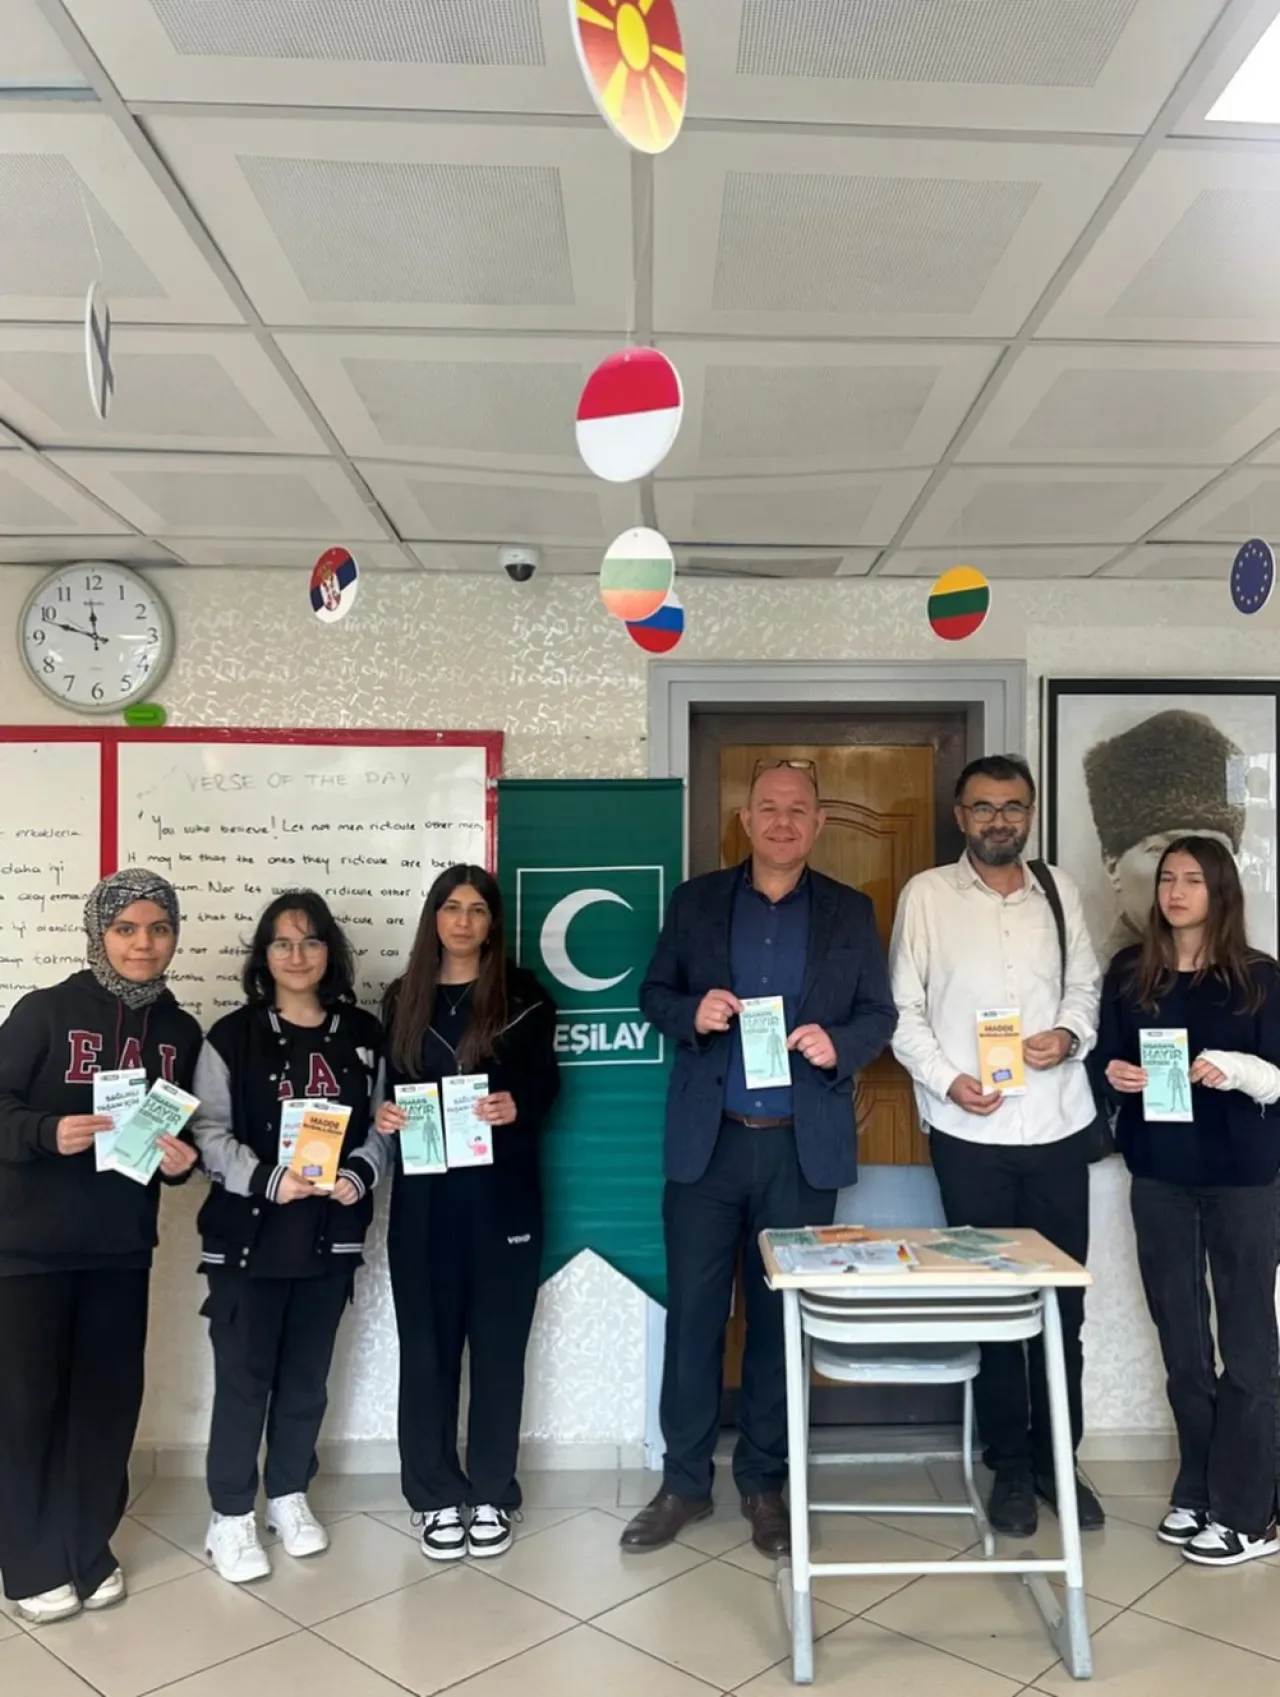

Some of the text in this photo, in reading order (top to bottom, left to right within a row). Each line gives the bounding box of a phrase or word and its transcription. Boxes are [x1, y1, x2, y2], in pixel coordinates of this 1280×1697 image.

[85, 575, 103, 590] 12
[57, 586, 71, 602] 11
[118, 585, 125, 600] 1
[41, 606, 56, 622] 10
[135, 603, 147, 620] 2
[33, 629, 46, 647] 9
[147, 627, 158, 644] 3
[43, 656, 55, 673] 8
[136, 655, 149, 672] 4
[63, 674, 75, 692] 7
[91, 682, 104, 699] 6
[120, 674, 132, 692] 5
[185, 771, 411, 792] VERSE OF THE DAY
[184, 824, 211, 834] who
[282, 819, 304, 833] Let
[311, 823, 331, 832] not
[338, 823, 364, 832] men
[369, 821, 416, 832] ridicule
[147, 855, 172, 871] may
[179, 852, 193, 862] be
[199, 853, 227, 863] that
[236, 854, 256, 865] the
[267, 856, 296, 865] ones
[302, 854, 331, 875] they
[340, 855, 388, 866] ridicule
[401, 859, 421, 869] are
[1, 860, 65, 886] daha iyi
[208, 881, 235, 894] Nor
[244, 883, 262, 894] let
[325, 886, 373, 897] ridicule
[380, 887, 412, 897] other
[198, 911, 227, 923] that
[386, 917, 405, 926] are
[189, 946, 209, 955] not
[553, 1021, 651, 1055] EŞİLAY
[1142, 1048, 1183, 1061] HAYIR
[144, 1099, 182, 1126] HAYIR
